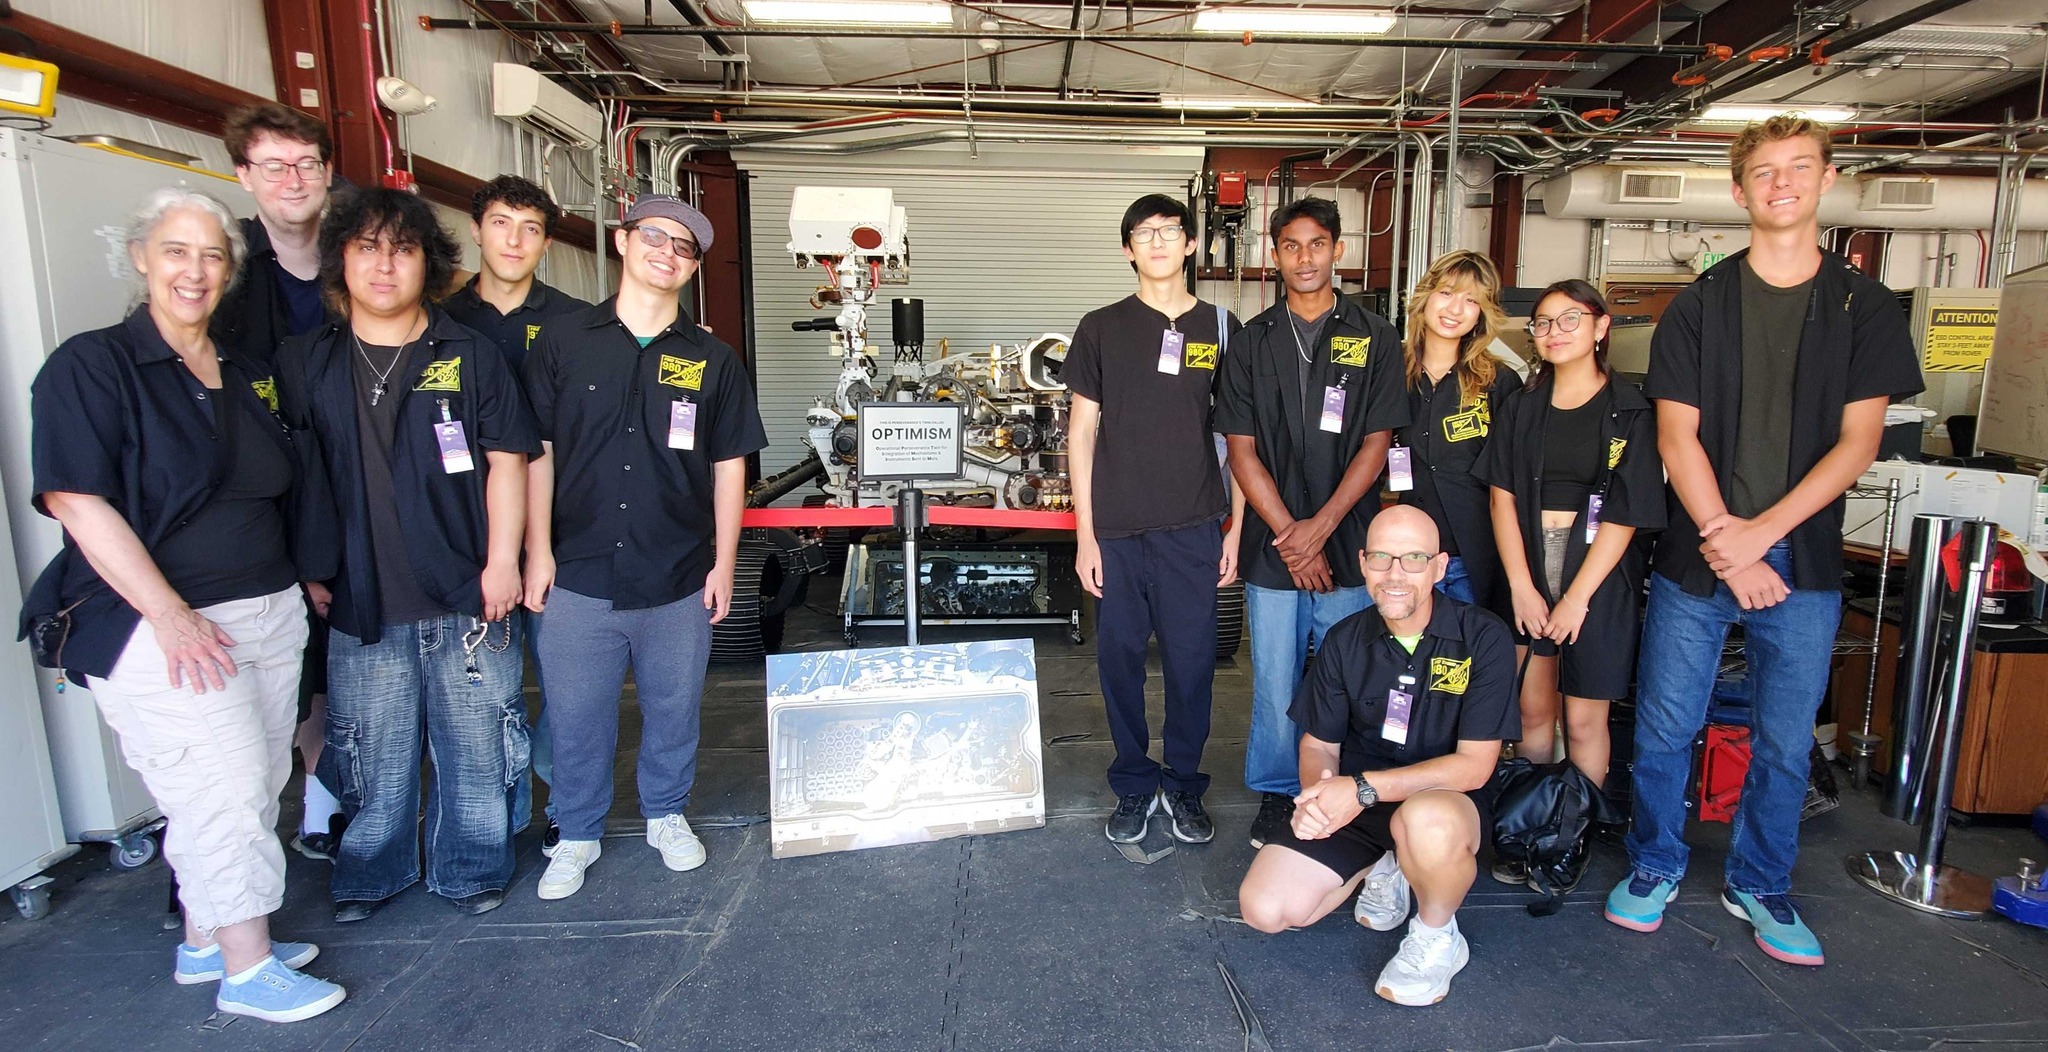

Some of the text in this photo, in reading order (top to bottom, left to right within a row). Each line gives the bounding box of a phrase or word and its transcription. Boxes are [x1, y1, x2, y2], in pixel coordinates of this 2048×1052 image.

[1936, 313, 1998, 324] ATTENTION
[1333, 342, 1349, 351] 980
[1188, 348, 1203, 357] 980
[662, 361, 681, 373] 980
[872, 427, 952, 440] OPTIMISM
